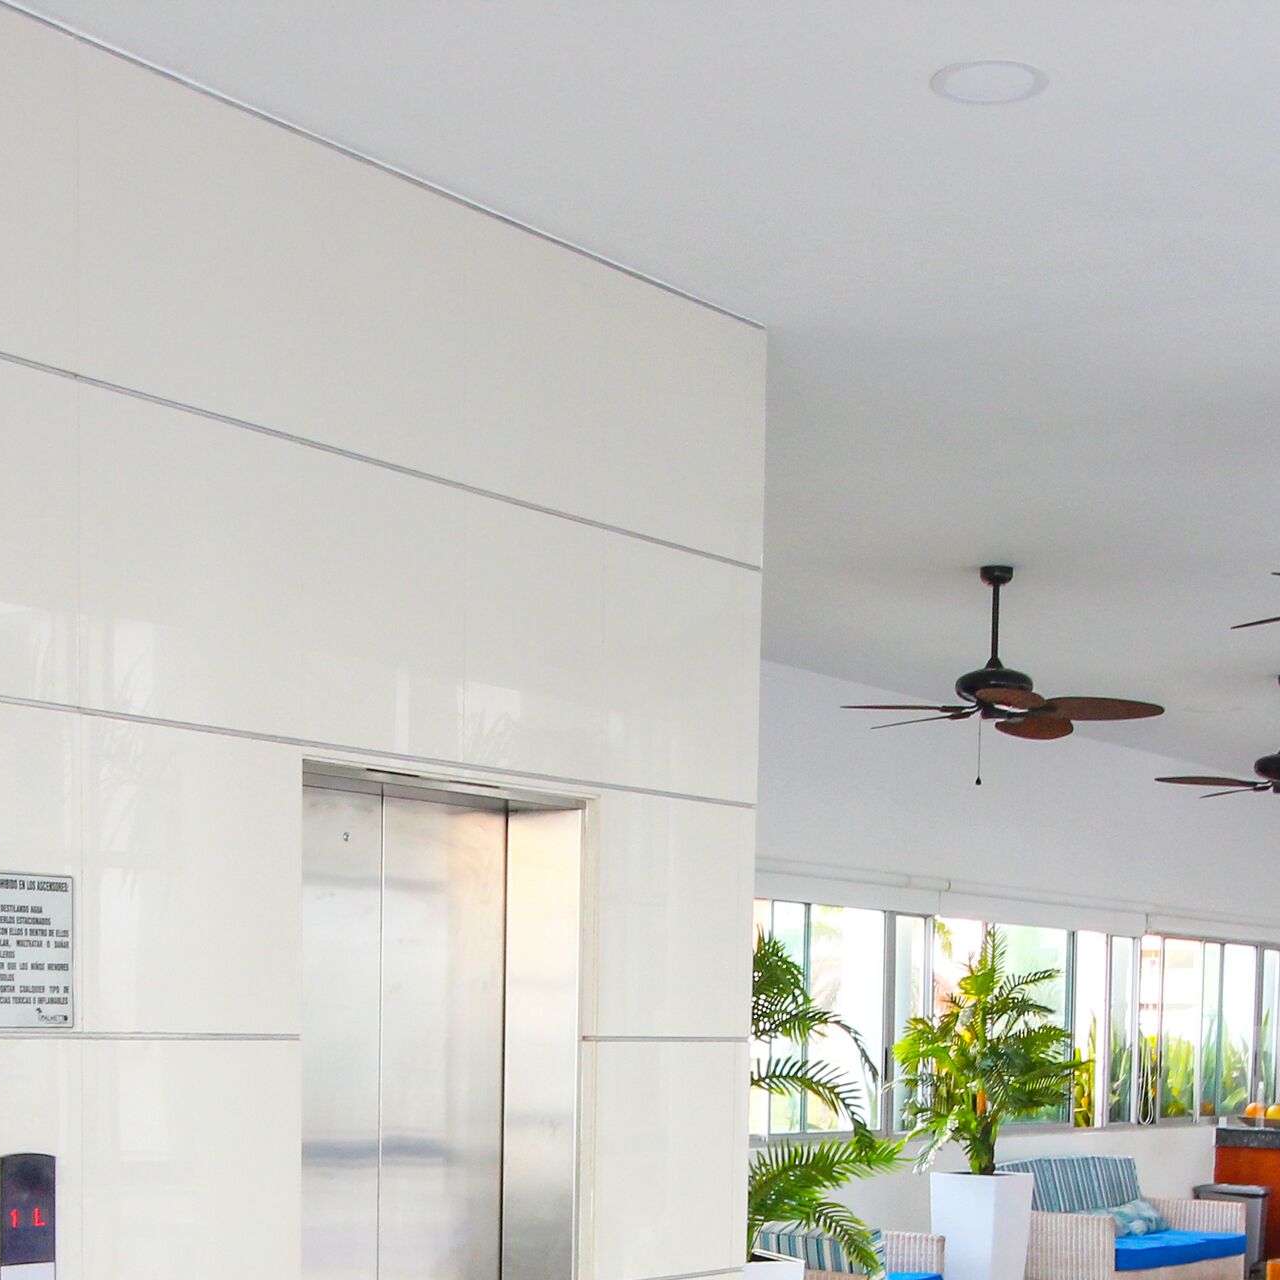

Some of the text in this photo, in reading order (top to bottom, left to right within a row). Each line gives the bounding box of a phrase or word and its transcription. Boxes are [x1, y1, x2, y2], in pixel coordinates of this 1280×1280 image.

[19, 880, 25, 890] EN
[27, 880, 35, 890] LOS
[1, 904, 29, 913] DESTILANDO
[9, 927, 23, 936] ELLOS
[29, 928, 47, 936] DENTRO
[10, 1207, 46, 1228] 1 L
